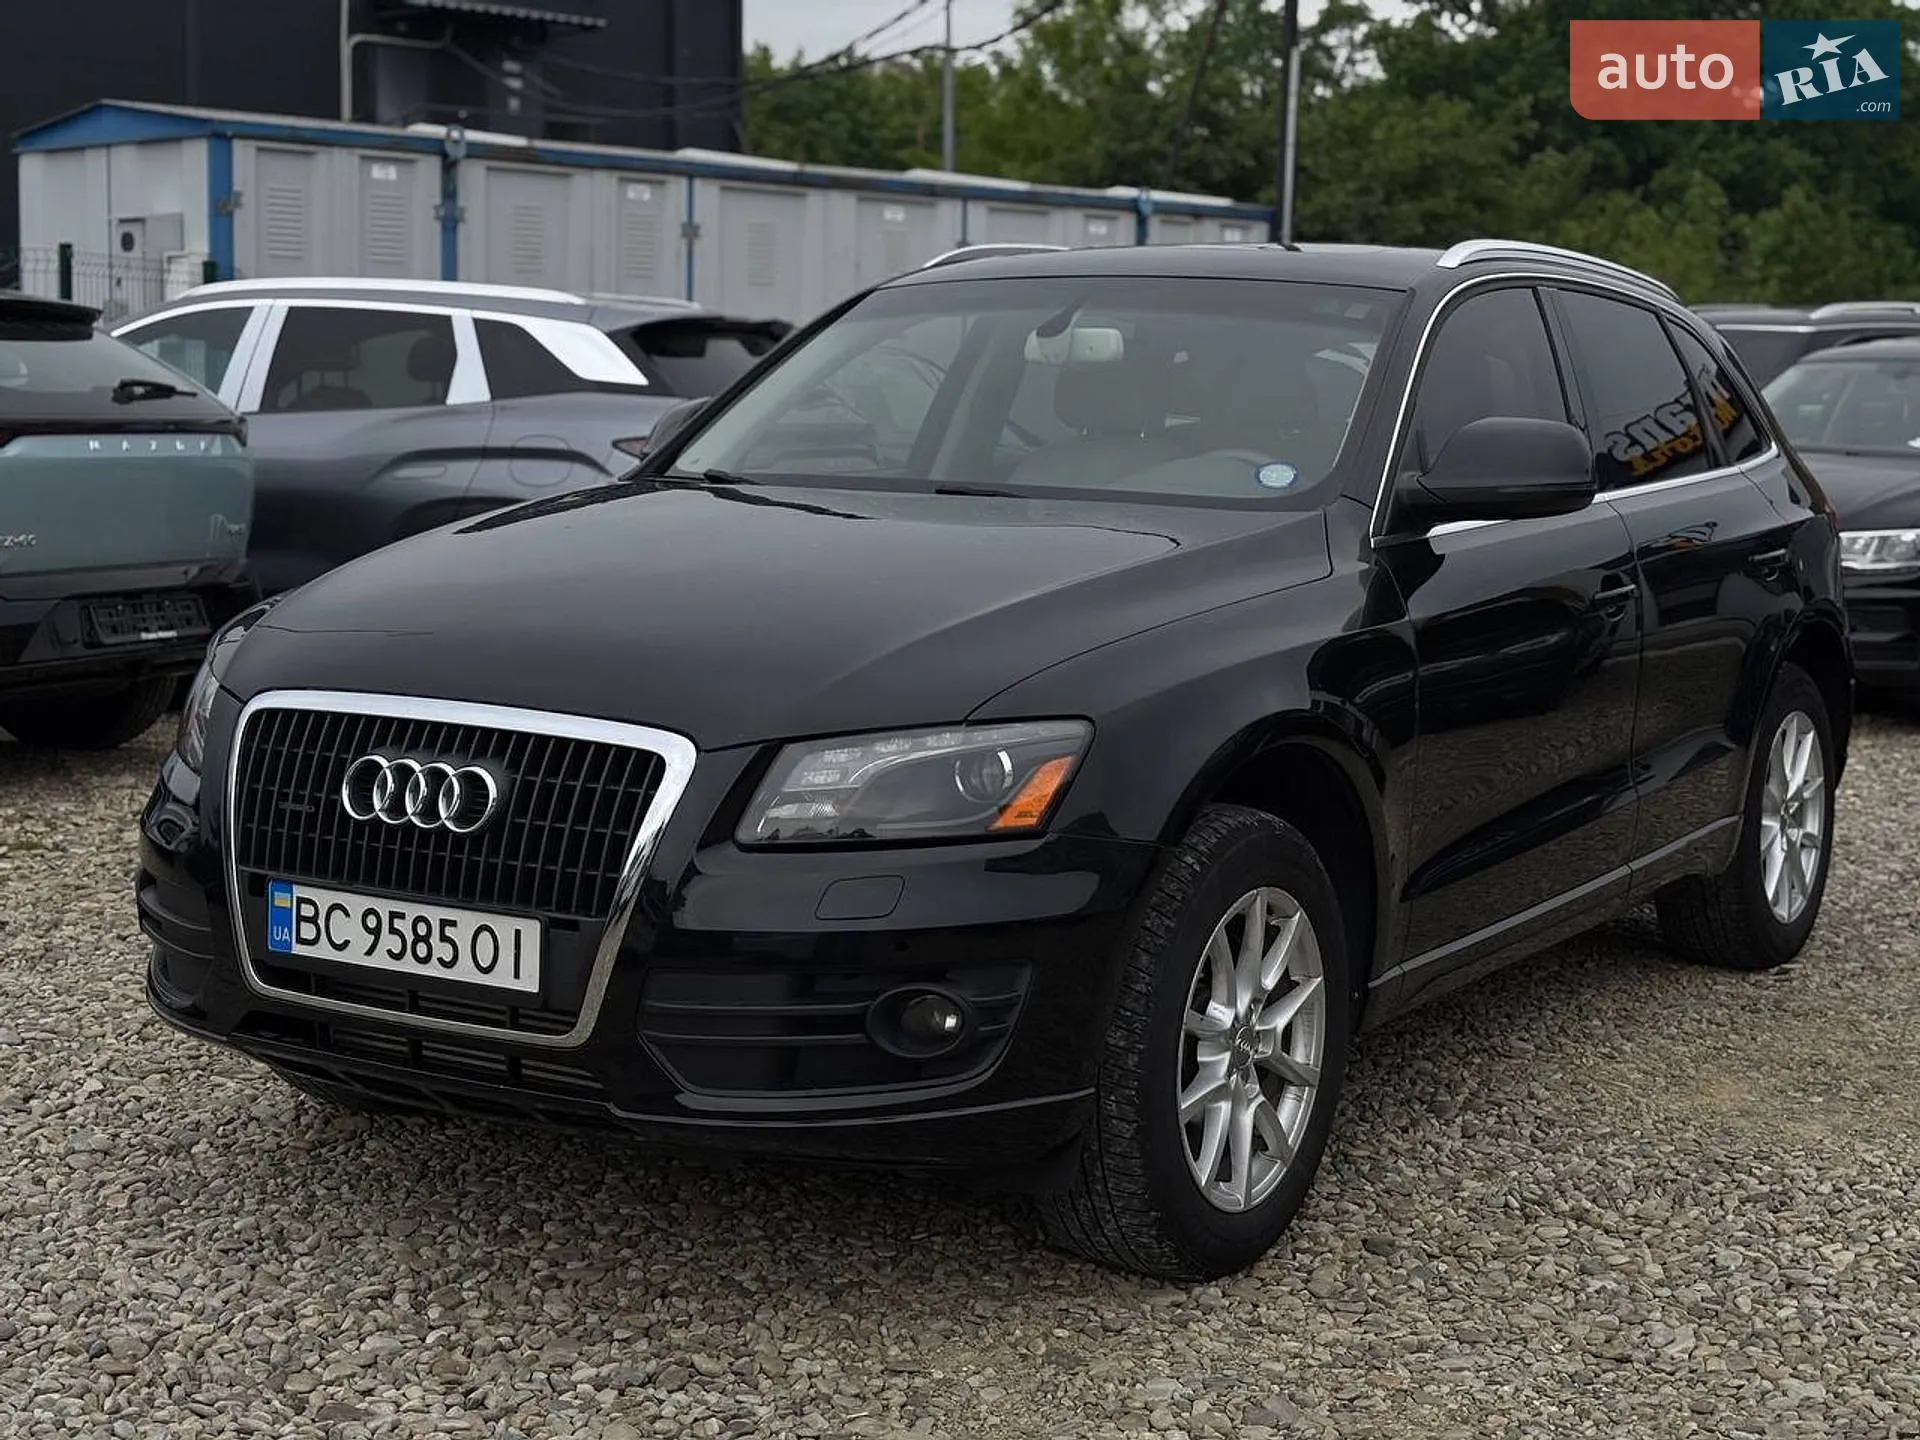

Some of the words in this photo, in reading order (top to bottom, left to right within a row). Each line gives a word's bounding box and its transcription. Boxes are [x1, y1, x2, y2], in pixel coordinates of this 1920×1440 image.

[273, 926, 290, 942] UA
[295, 895, 351, 951] BC
[361, 907, 460, 970] 9585
[470, 923, 522, 980] OI
